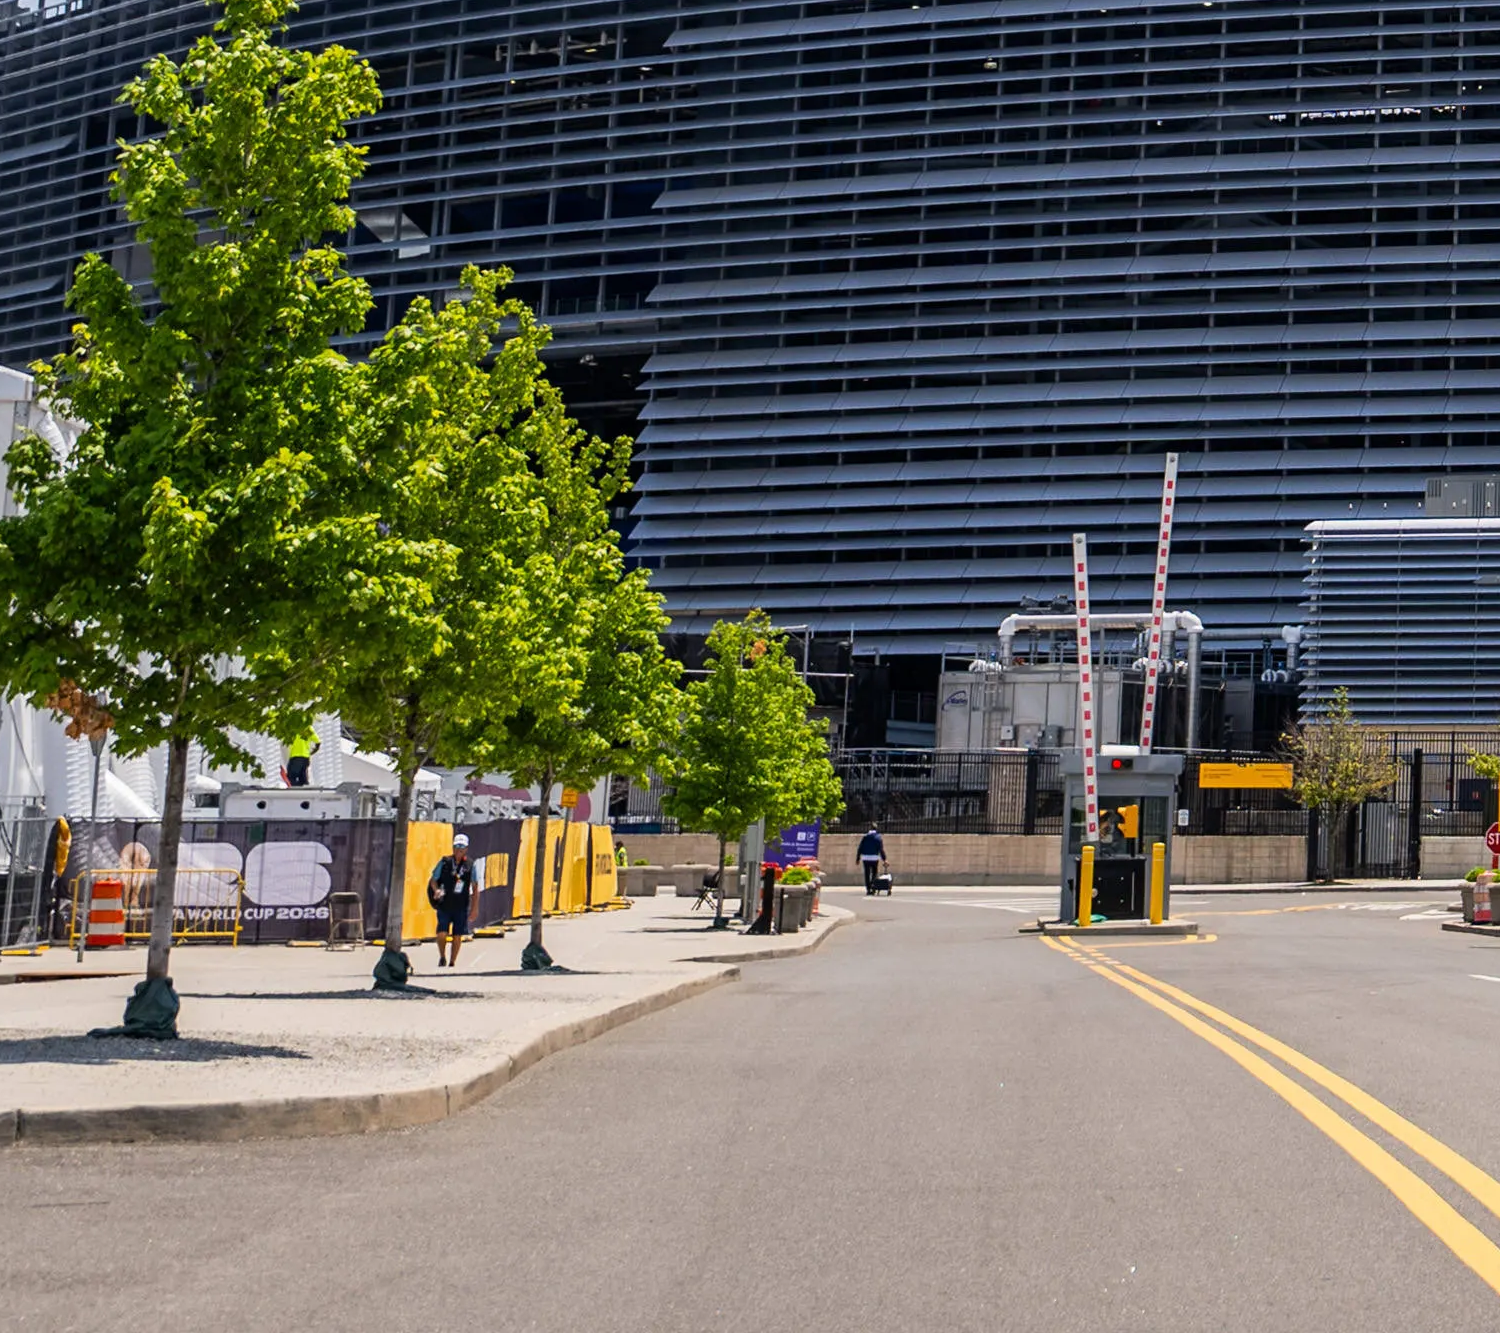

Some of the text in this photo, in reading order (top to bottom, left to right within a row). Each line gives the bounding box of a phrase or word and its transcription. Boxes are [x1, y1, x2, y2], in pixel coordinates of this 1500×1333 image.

[188, 908, 241, 920] WORLD
[243, 907, 275, 920] CUP
[276, 907, 330, 920] 2026
